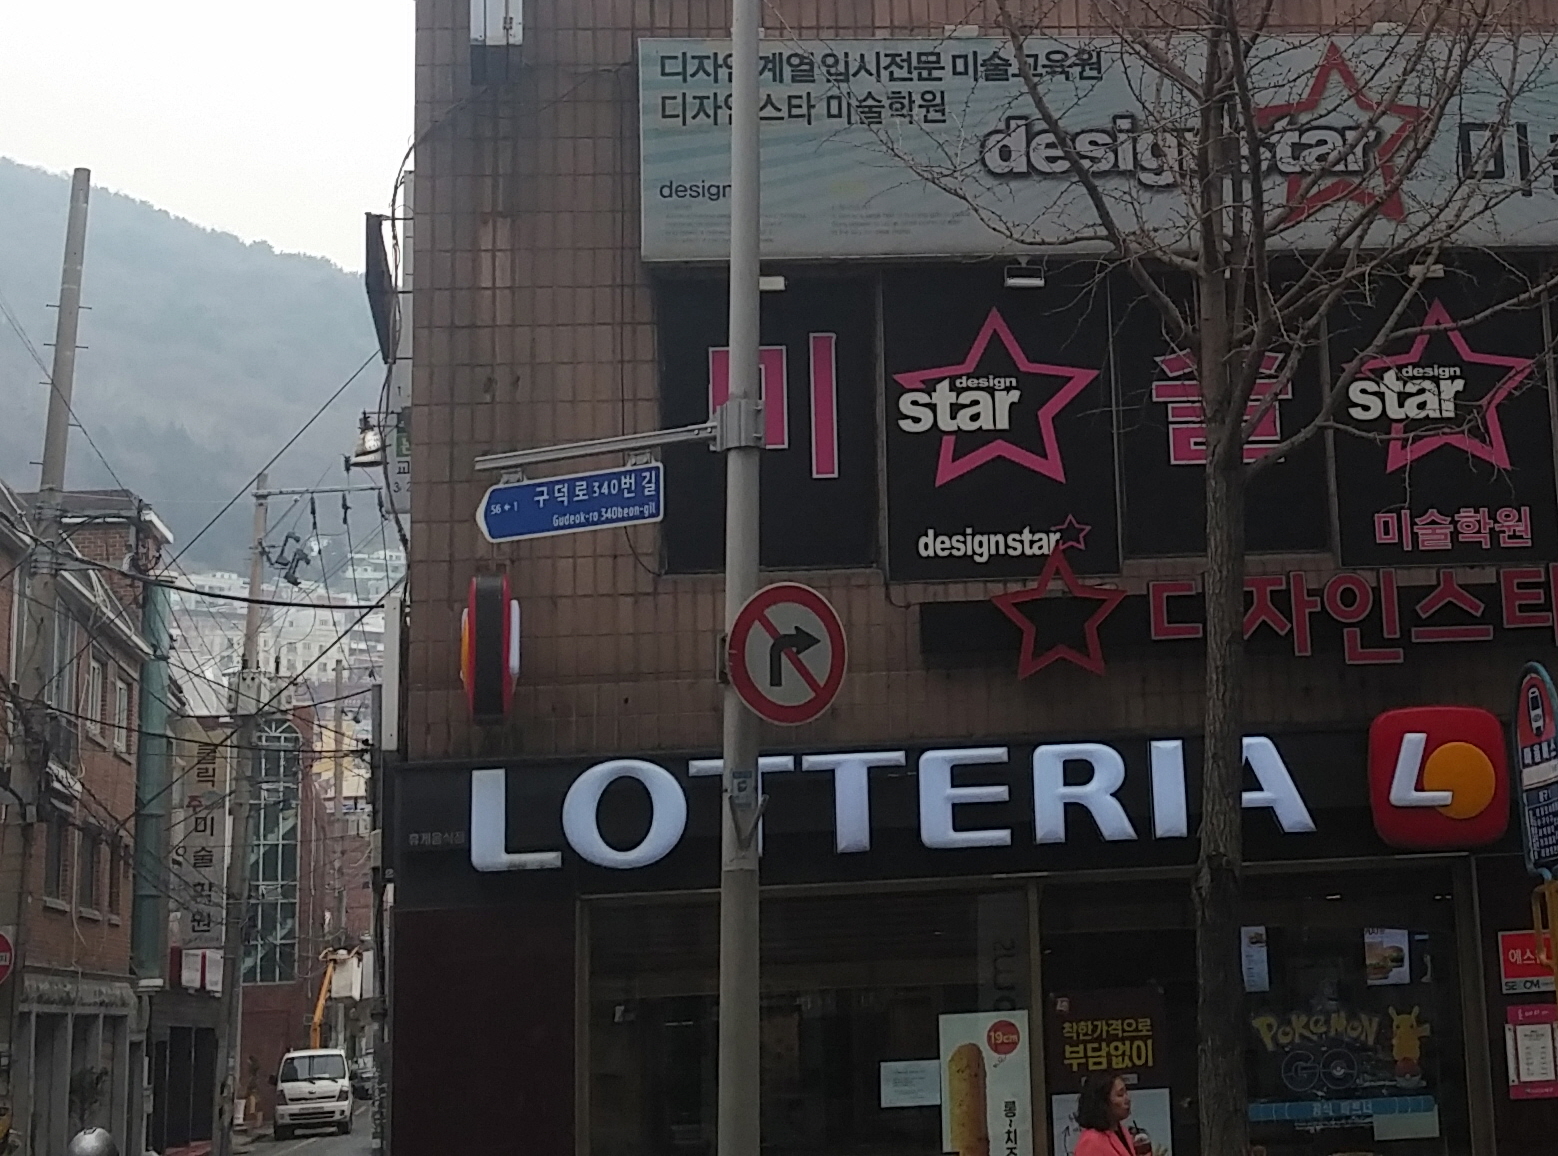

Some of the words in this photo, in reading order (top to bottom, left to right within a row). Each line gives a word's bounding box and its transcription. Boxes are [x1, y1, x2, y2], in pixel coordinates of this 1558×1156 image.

[659, 49, 815, 84] 디자계열
[660, 91, 816, 127] 디자스타
[826, 90, 947, 125] 미술학원
[955, 375, 1017, 391] design
[1401, 364, 1461, 380] design
[897, 381, 1020, 434] star
[1347, 373, 1464, 422] star
[533, 469, 657, 509] 구덕로340번길
[552, 511, 599, 527] Gudeok-ro
[600, 500, 657, 522] 340beon-gil
[1373, 506, 1532, 550] 미술학원
[918, 525, 1062, 564] designstar
[989, 1030, 1019, 1045] 19cm
[1062, 1018, 1153, 1041] 착한가격으로
[1063, 1039, 1154, 1072] 부담없이
[1282, 1049, 1358, 1092] GO
